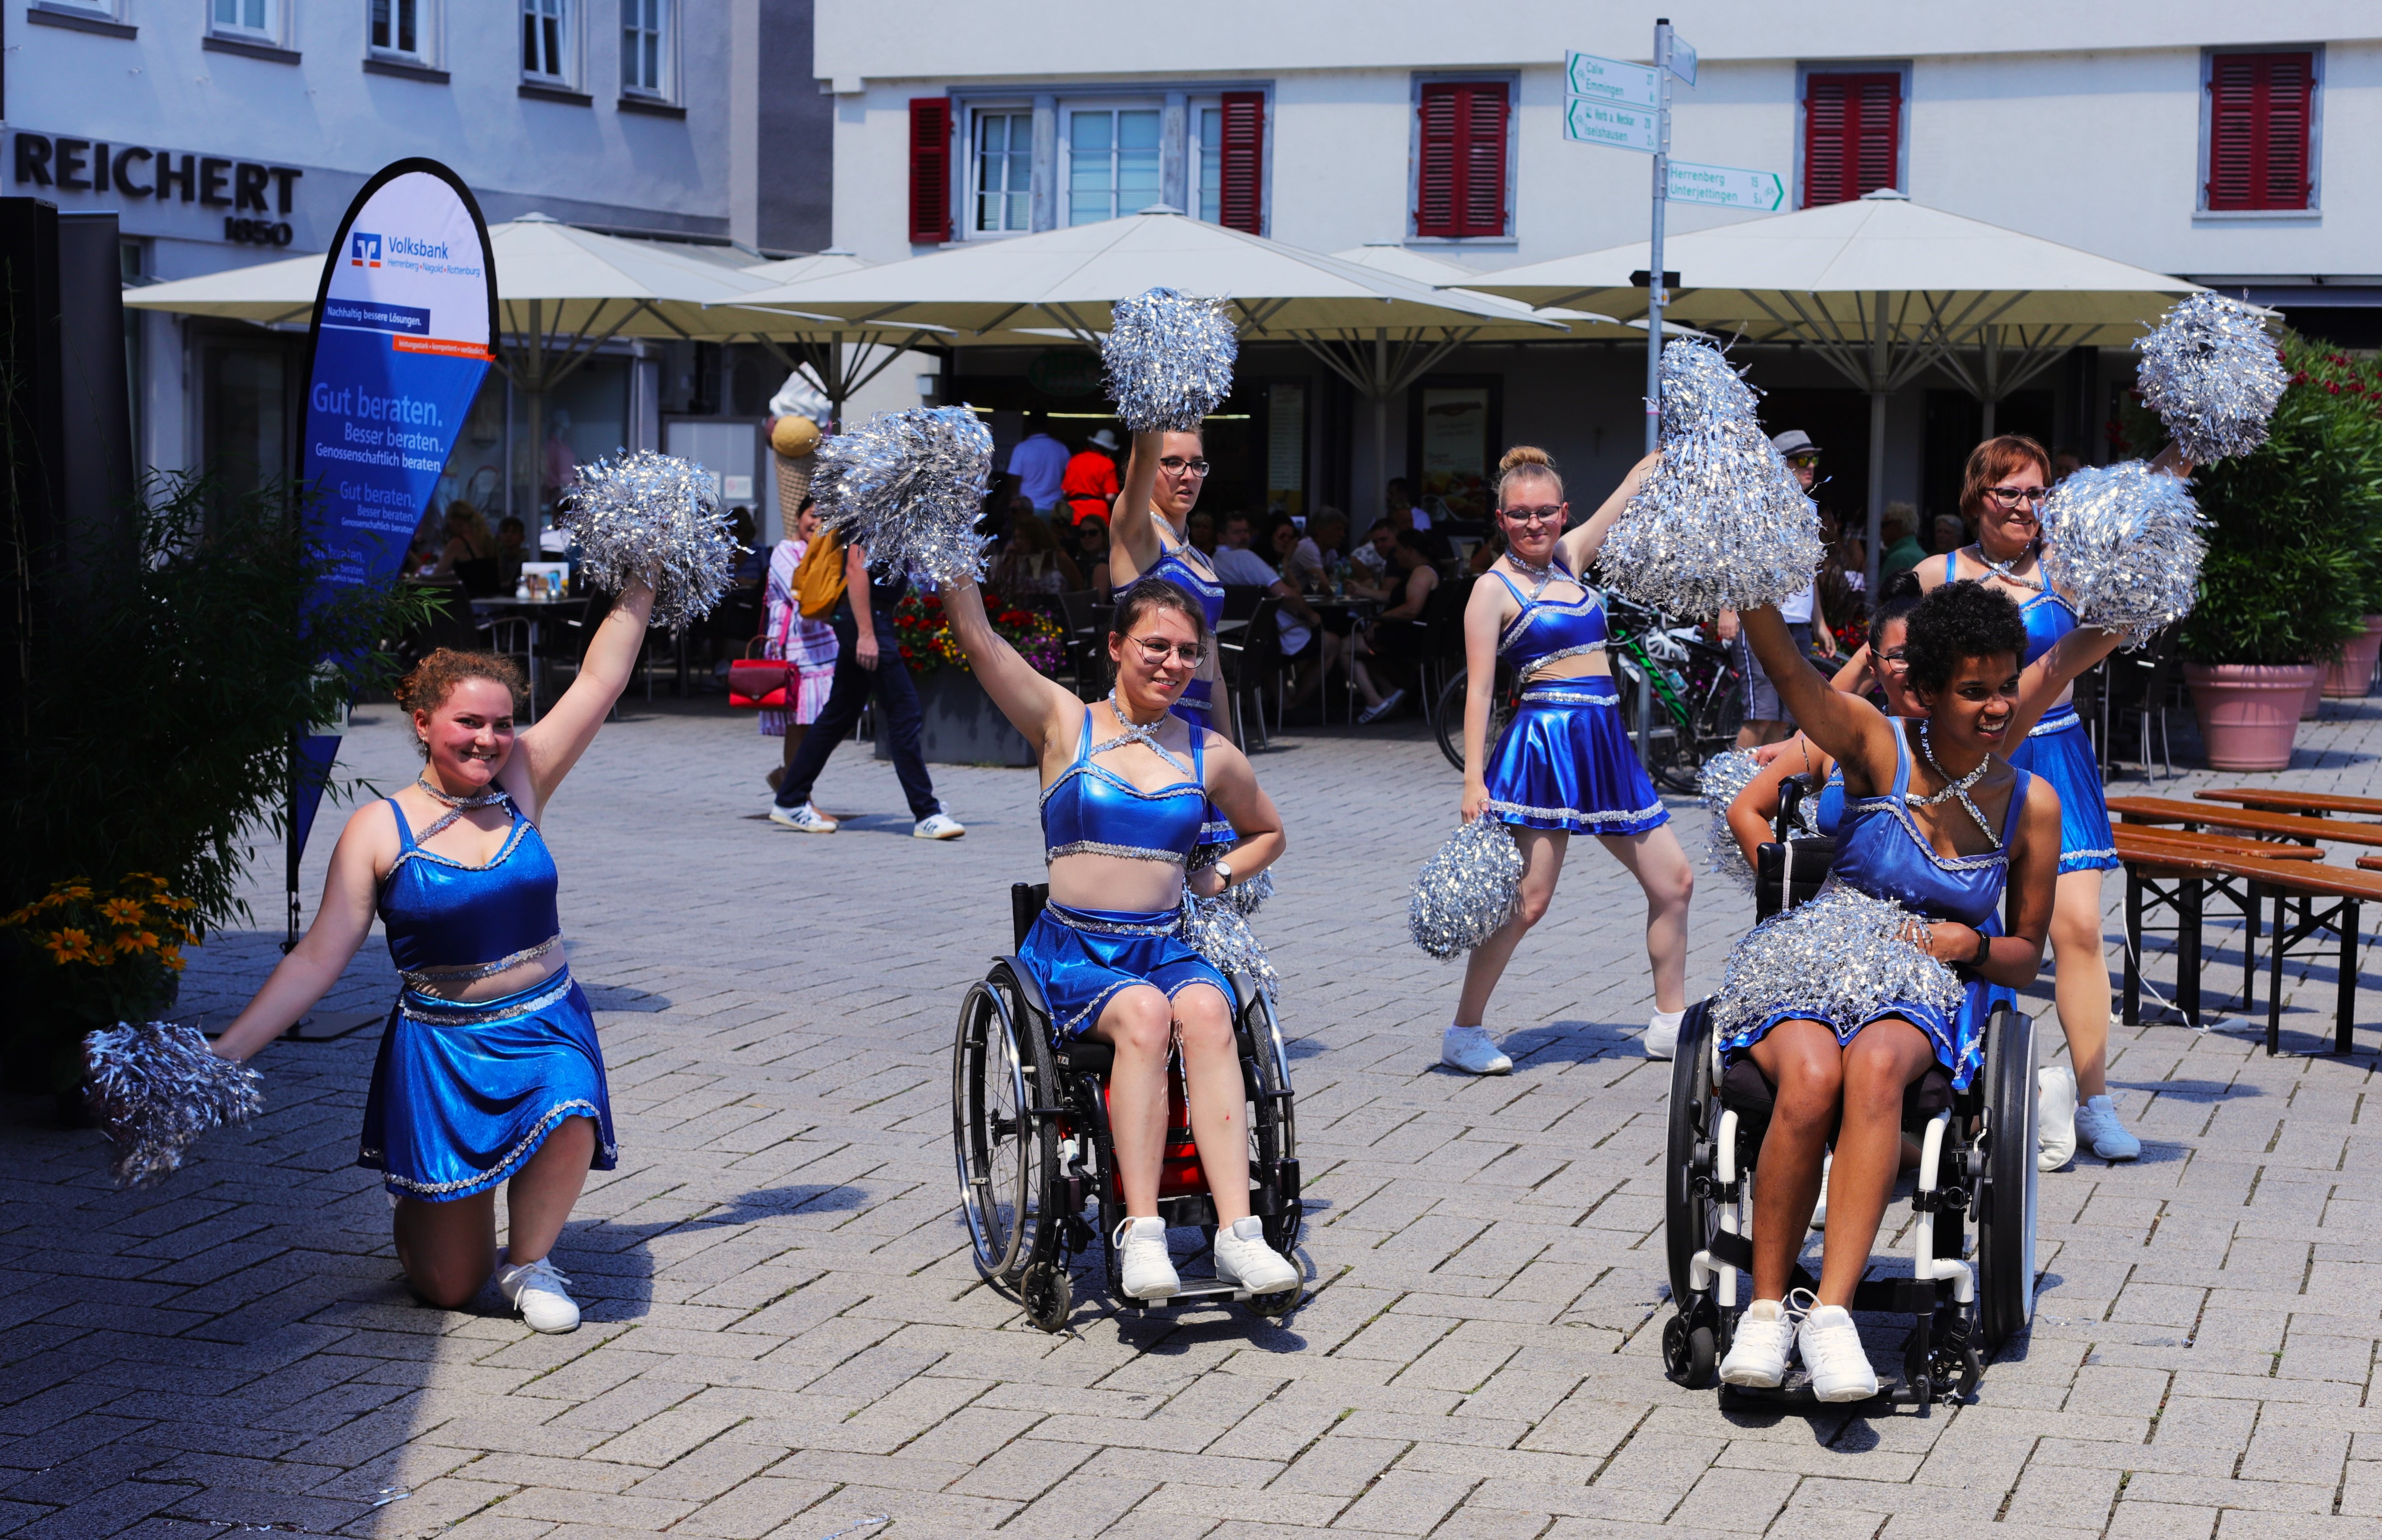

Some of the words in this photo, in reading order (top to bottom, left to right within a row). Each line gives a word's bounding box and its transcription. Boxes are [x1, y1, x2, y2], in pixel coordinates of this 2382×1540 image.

[1586, 61, 1604, 75] Calw
[1647, 74, 1653, 85] 27
[1586, 77, 1624, 98] Emmingen
[1594, 108, 1607, 122] Horb
[1616, 112, 1635, 126] Neckar
[1644, 116, 1652, 129] 20
[1585, 123, 1628, 142] Iselshausen
[15, 132, 303, 214] REICHERT
[1671, 166, 1725, 187] Herrenberg
[1751, 176, 1759, 188] 15
[1671, 182, 1738, 204] Unterjettingen
[225, 216, 293, 247] 1850
[388, 236, 448, 260] Volksbank
[387, 257, 419, 272] Herrenberg
[423, 262, 443, 274] Nagold
[447, 265, 480, 278] Rottenburg
[327, 306, 362, 321] Nachhaltig
[363, 309, 388, 322] bessere
[389, 312, 422, 327] Lösungen.
[399, 339, 429, 351] leistungsstark
[432, 343, 457, 352] kompetent
[313, 382, 351, 416] Gut
[357, 385, 443, 427] beraten.
[344, 421, 384, 446] Besser
[386, 426, 443, 453] beraten.
[316, 442, 399, 467] Genossenschaftlich
[340, 481, 361, 501] Gut
[364, 482, 415, 508] beraten.
[341, 517, 391, 531] Genossenschaftlich
[357, 504, 381, 518] Besser
[382, 506, 415, 523] beraten.
